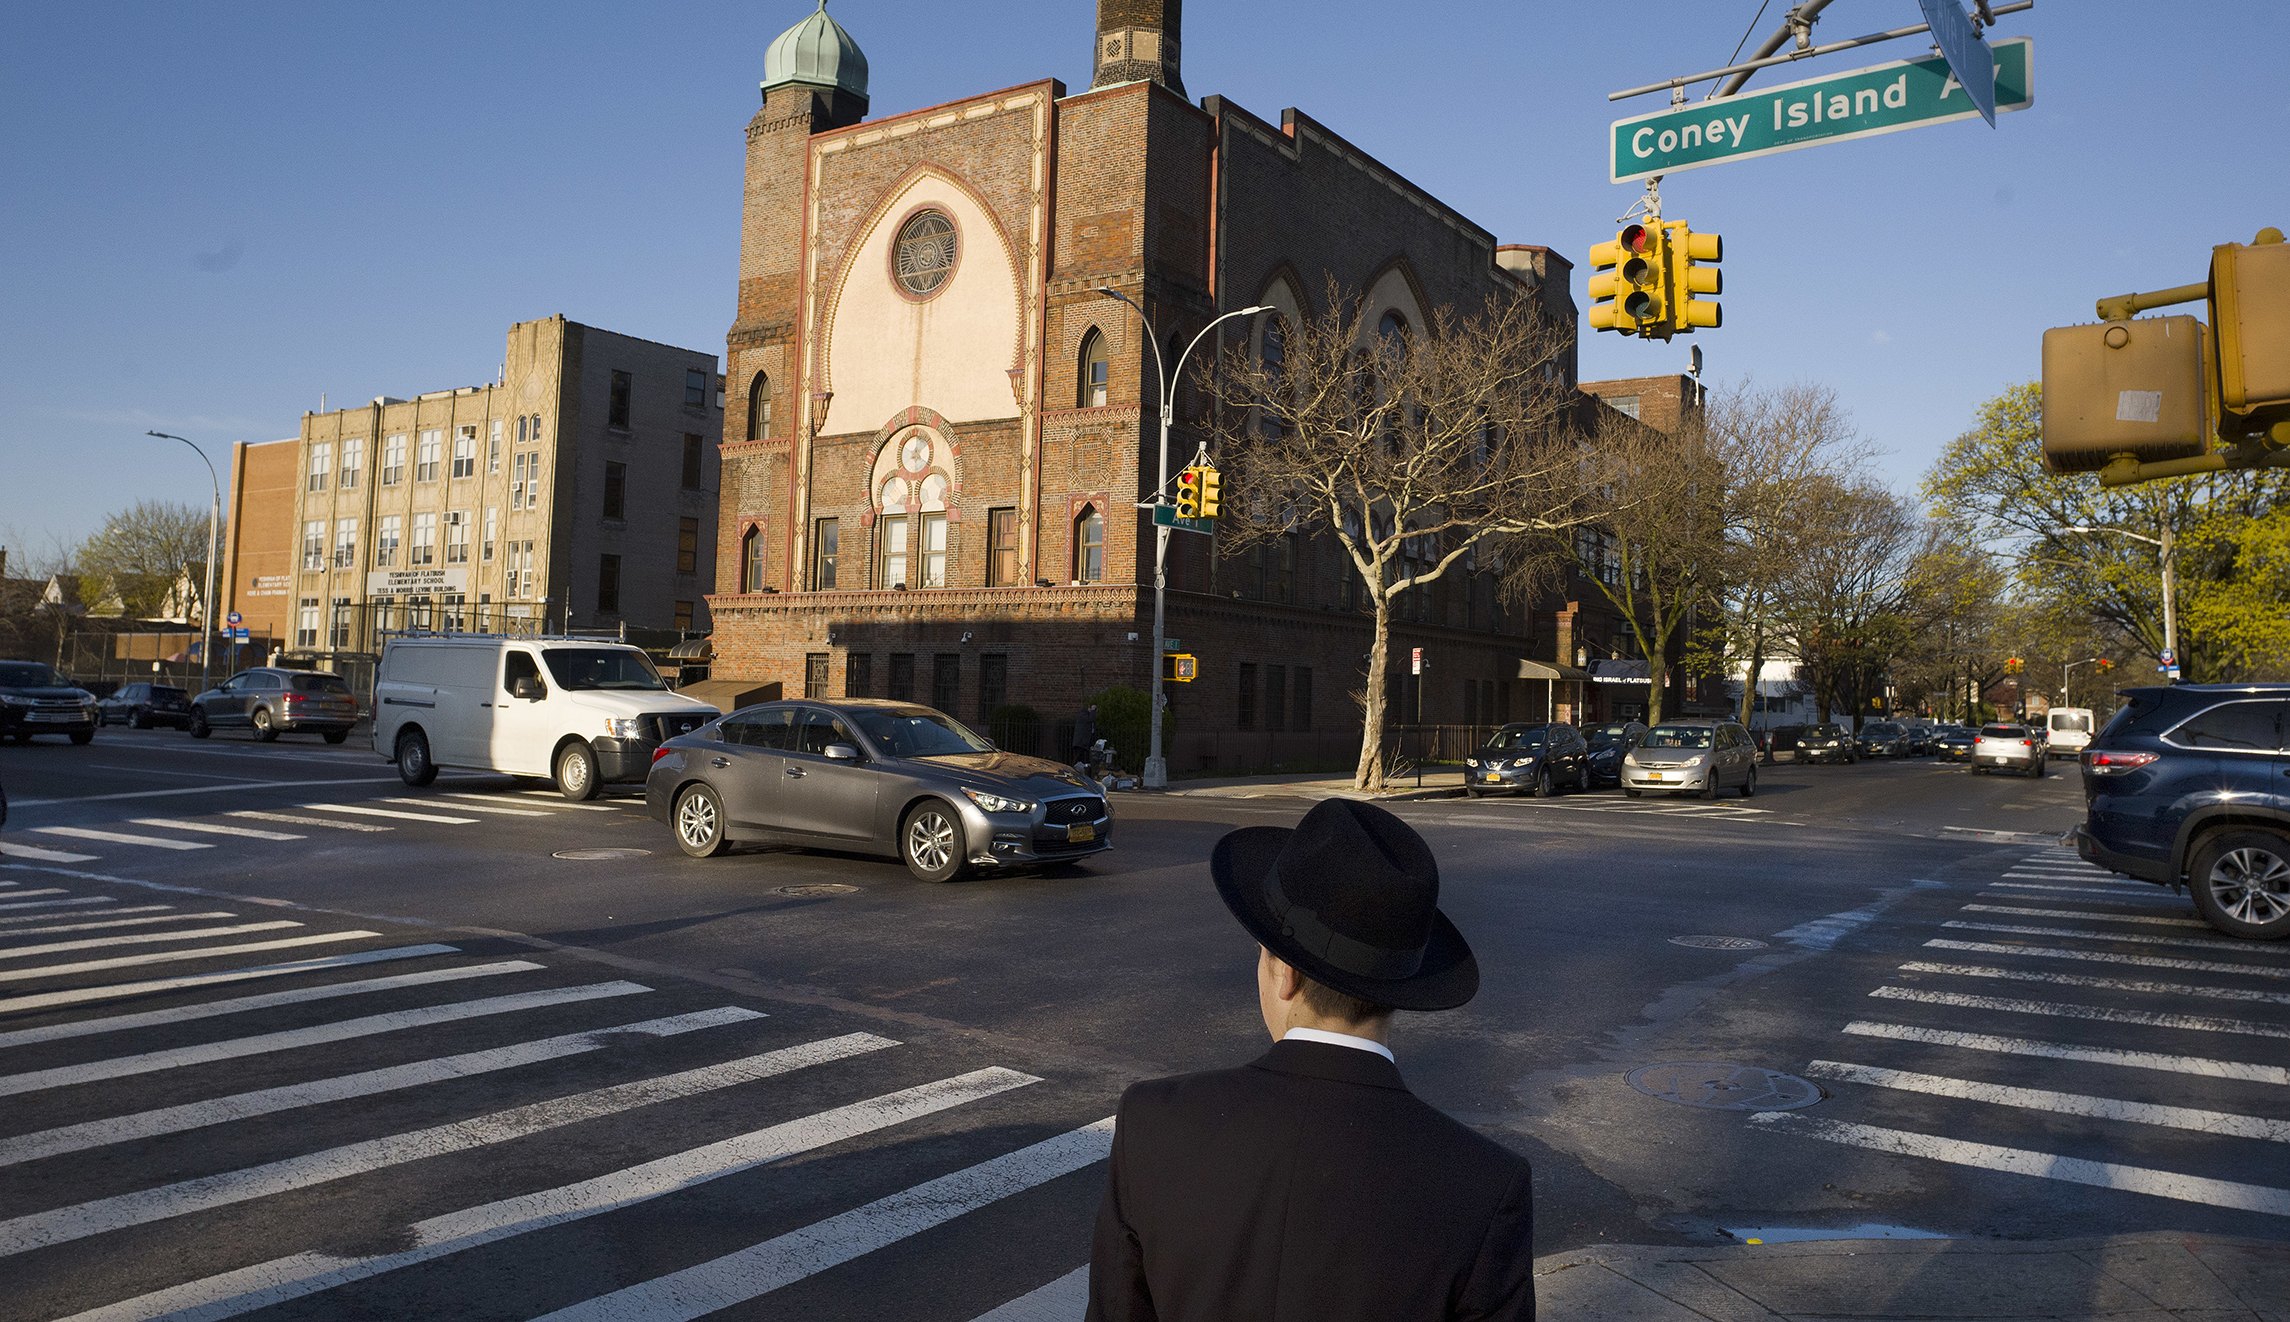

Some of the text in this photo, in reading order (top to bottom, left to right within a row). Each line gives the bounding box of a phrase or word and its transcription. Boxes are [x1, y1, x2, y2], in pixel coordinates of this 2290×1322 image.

[1632, 113, 1750, 158] Coney
[1774, 73, 1906, 131] Island
[1172, 512, 1190, 526] Ave
[388, 578, 421, 586] ELEMENTARY
